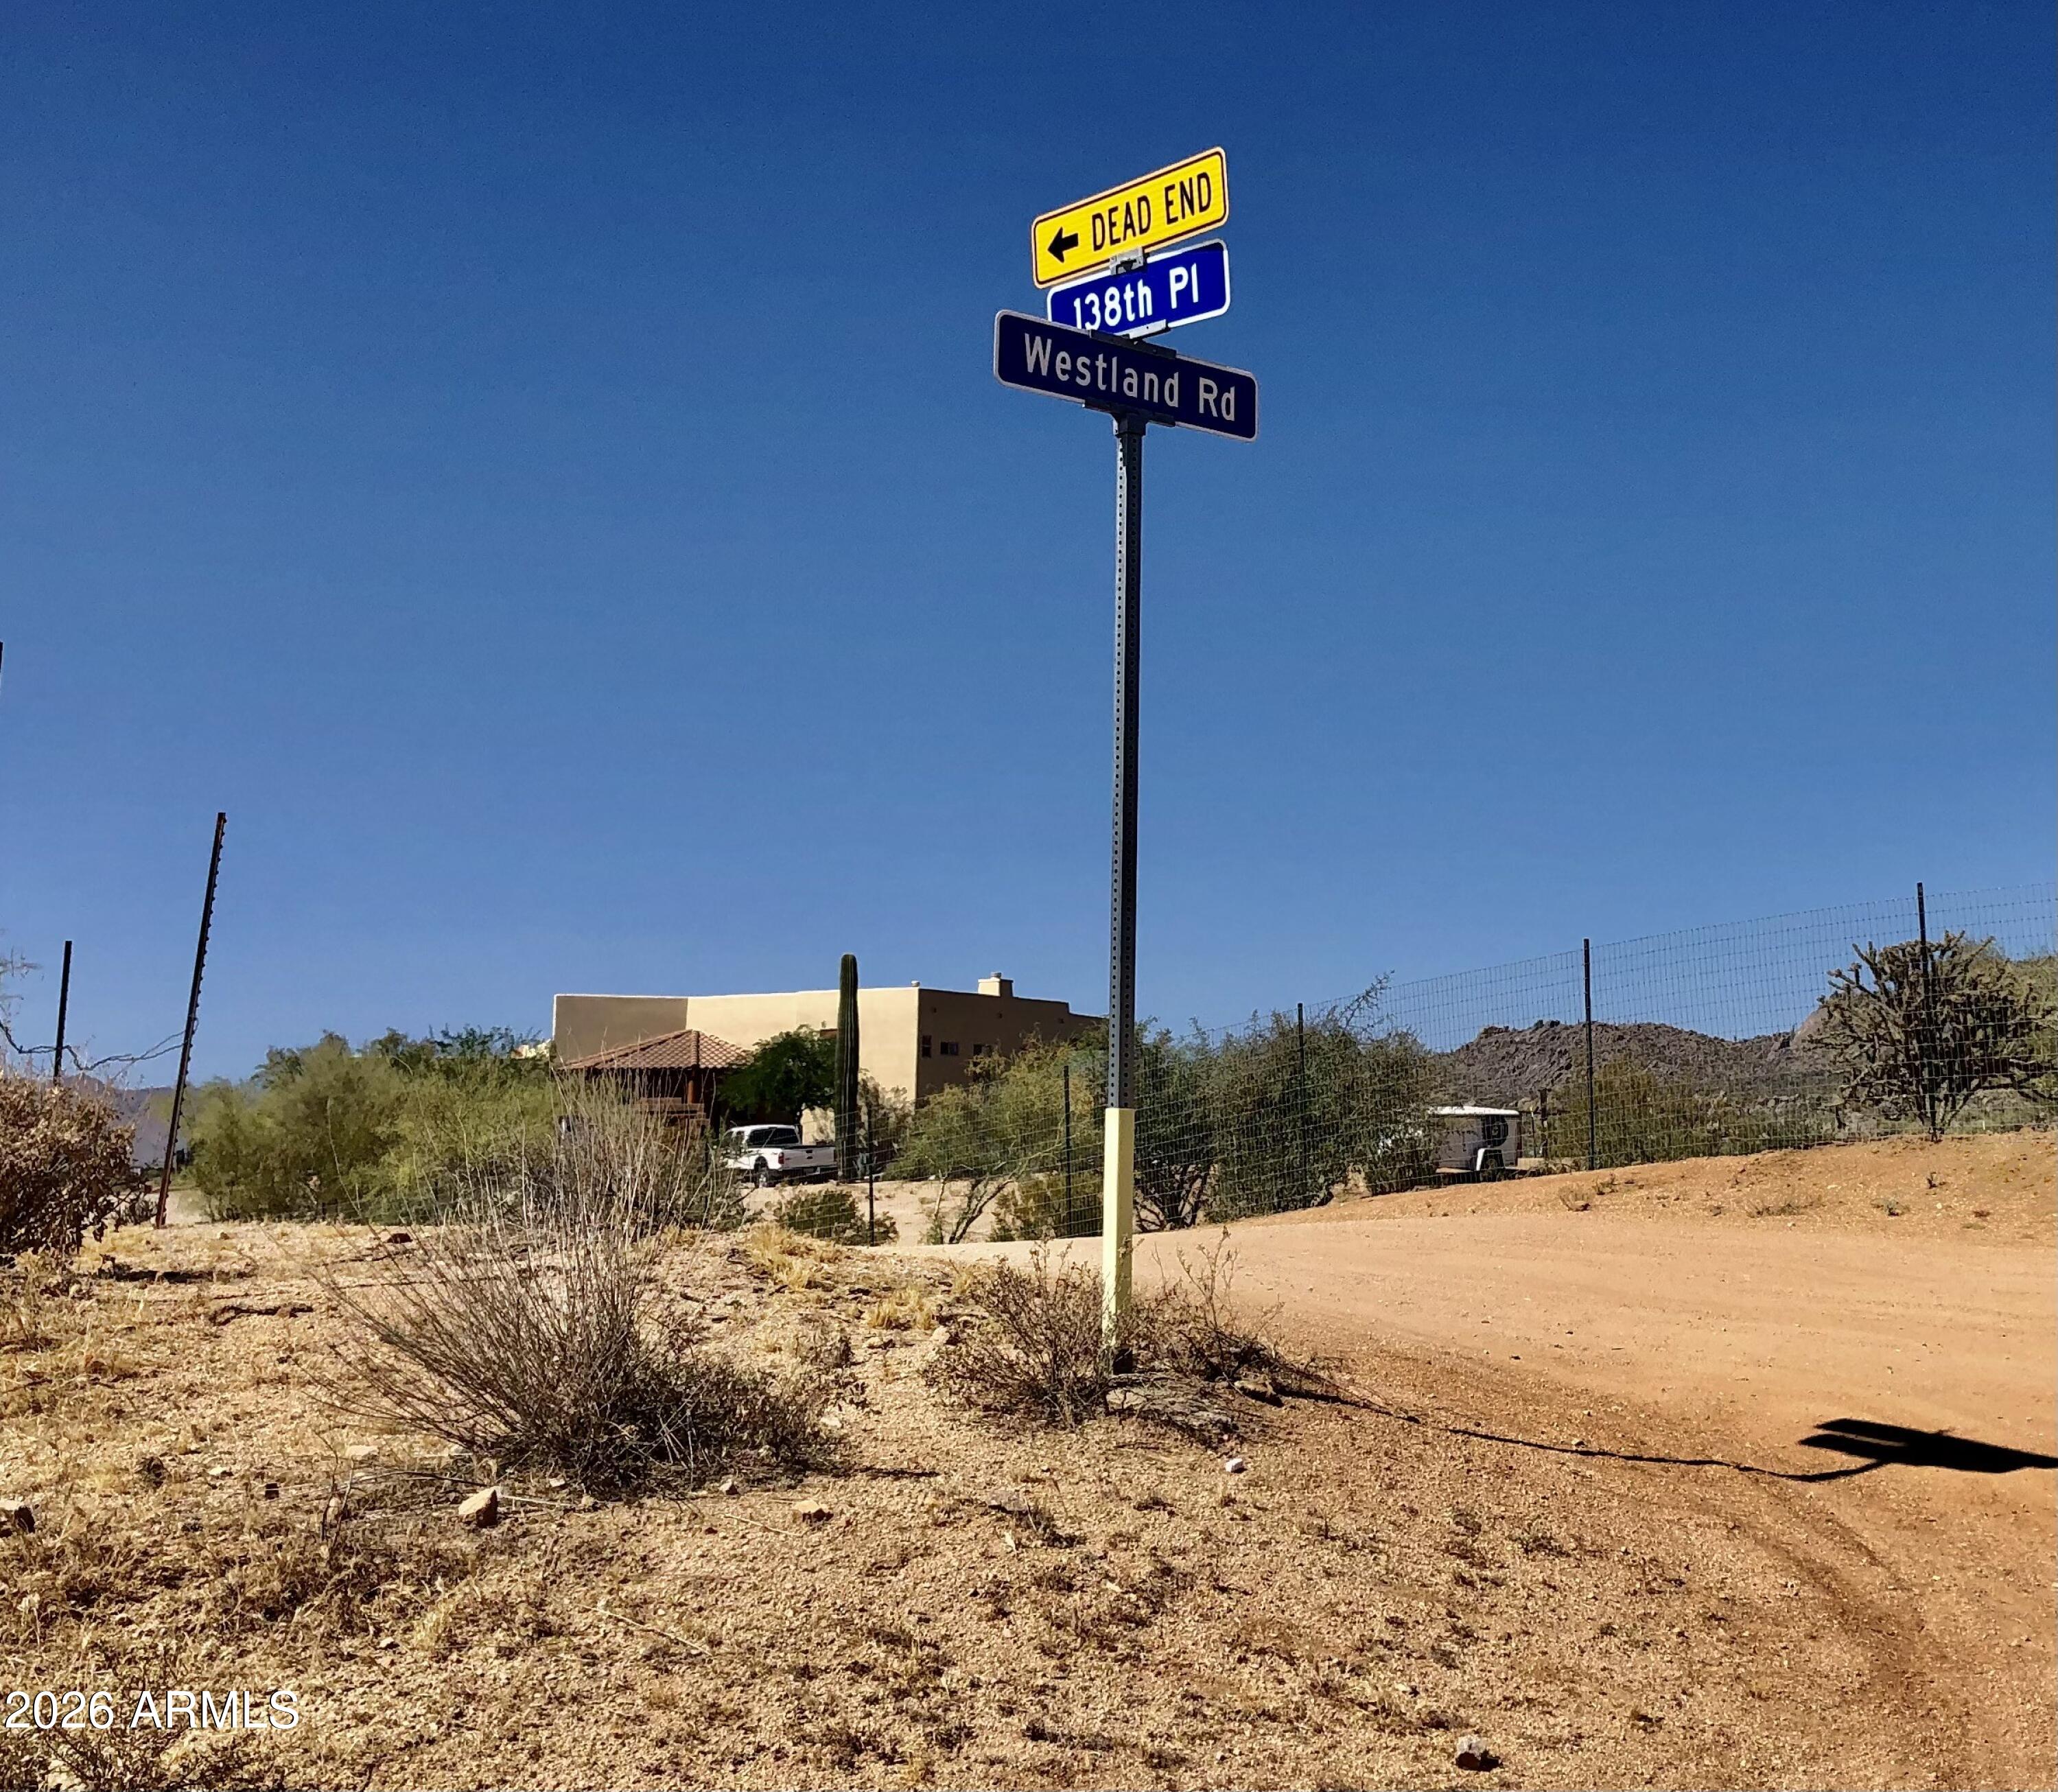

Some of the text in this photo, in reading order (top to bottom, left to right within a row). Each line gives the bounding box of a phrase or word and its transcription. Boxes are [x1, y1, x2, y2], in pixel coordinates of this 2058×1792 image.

[1091, 172, 1212, 251] DEAD END
[1073, 263, 1199, 331] 138th Pl
[1025, 333, 1235, 421] Westland Rd
